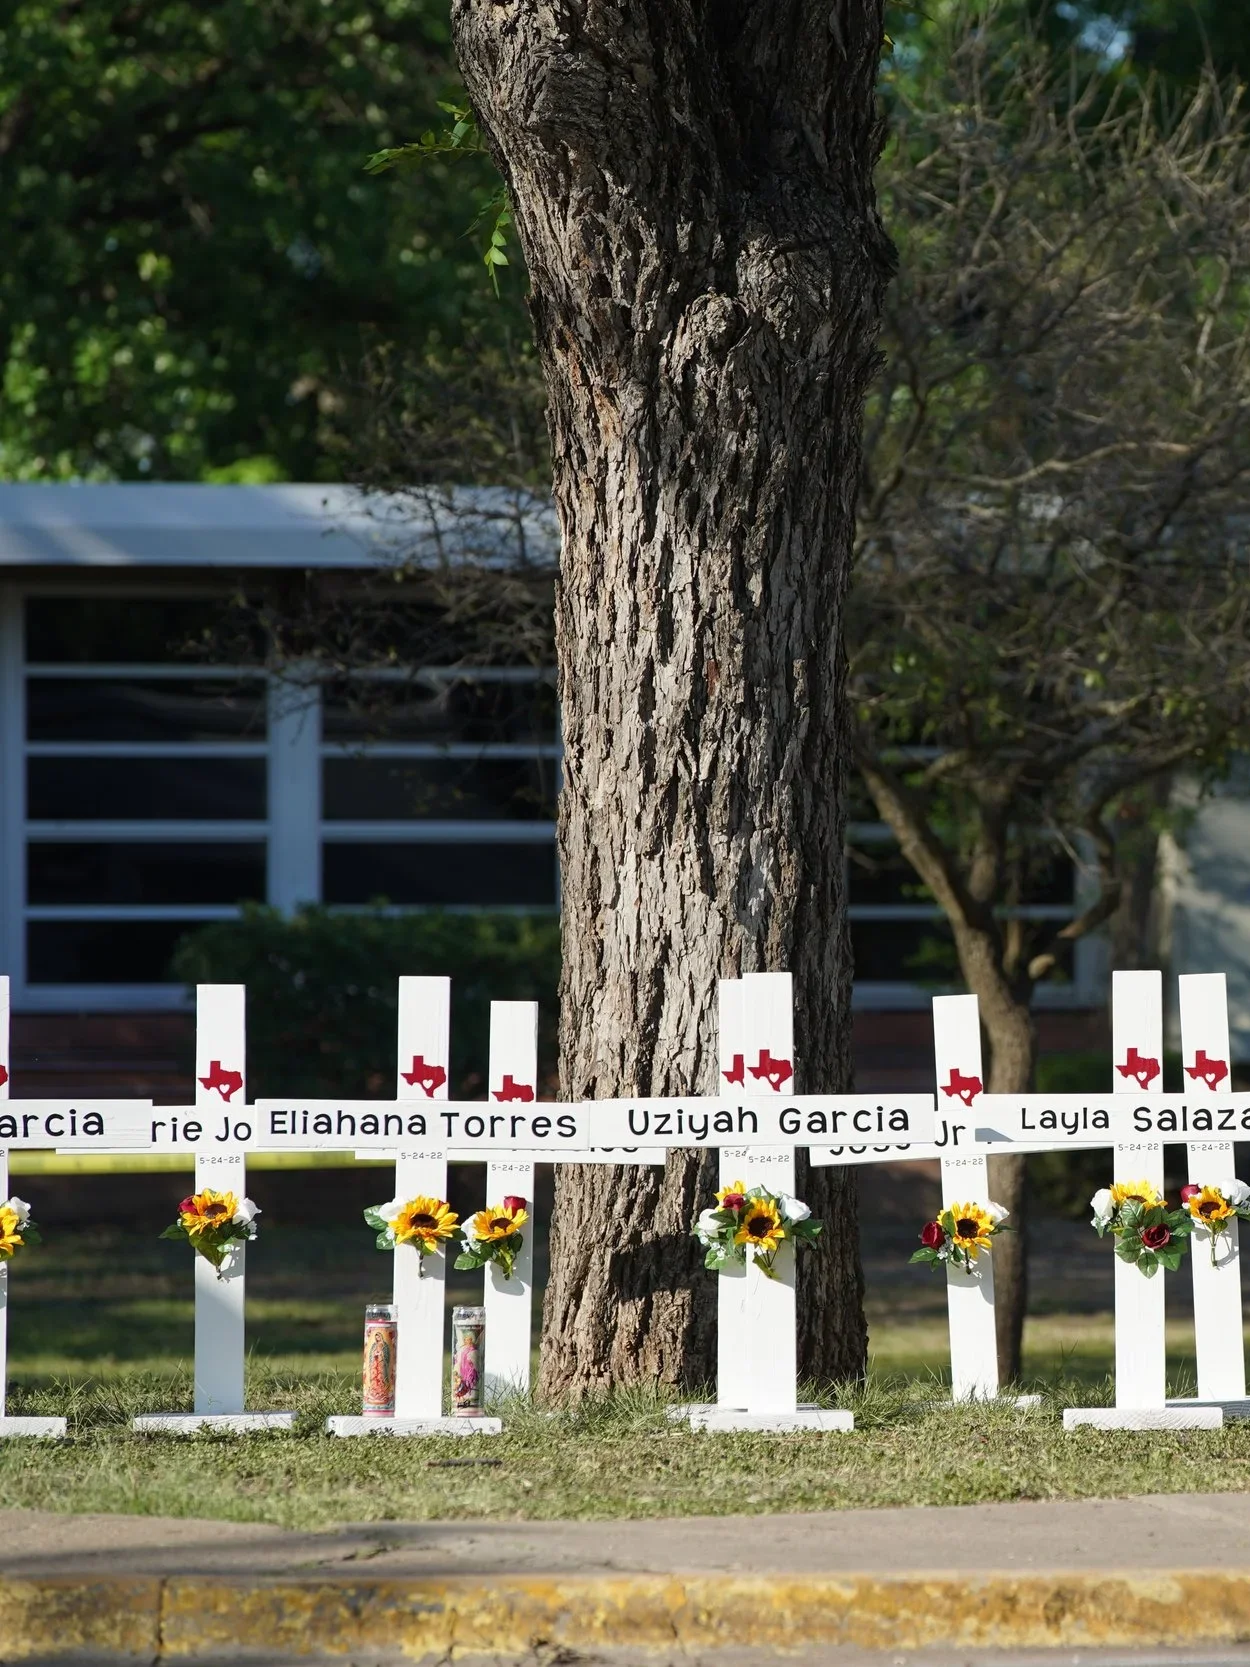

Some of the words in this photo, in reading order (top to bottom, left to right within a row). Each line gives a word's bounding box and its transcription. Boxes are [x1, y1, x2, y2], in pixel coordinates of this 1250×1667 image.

[270, 1109, 427, 1136] Eliahana
[440, 1112, 577, 1138] Torres
[628, 1106, 758, 1141] Uziyah
[779, 1105, 909, 1135] Garcia
[1021, 1107, 1110, 1136] Layla
[215, 1116, 252, 1142] Jo
[1118, 1142, 1159, 1152] 5-24-22
[1190, 1142, 1230, 1152] 5-24-22
[199, 1155, 241, 1165] 5-24-22
[400, 1151, 443, 1160] 5-24-22
[748, 1154, 790, 1164] 5-24-22
[491, 1163, 531, 1172] 5-24-22
[944, 1157, 984, 1168] 5-24-22
